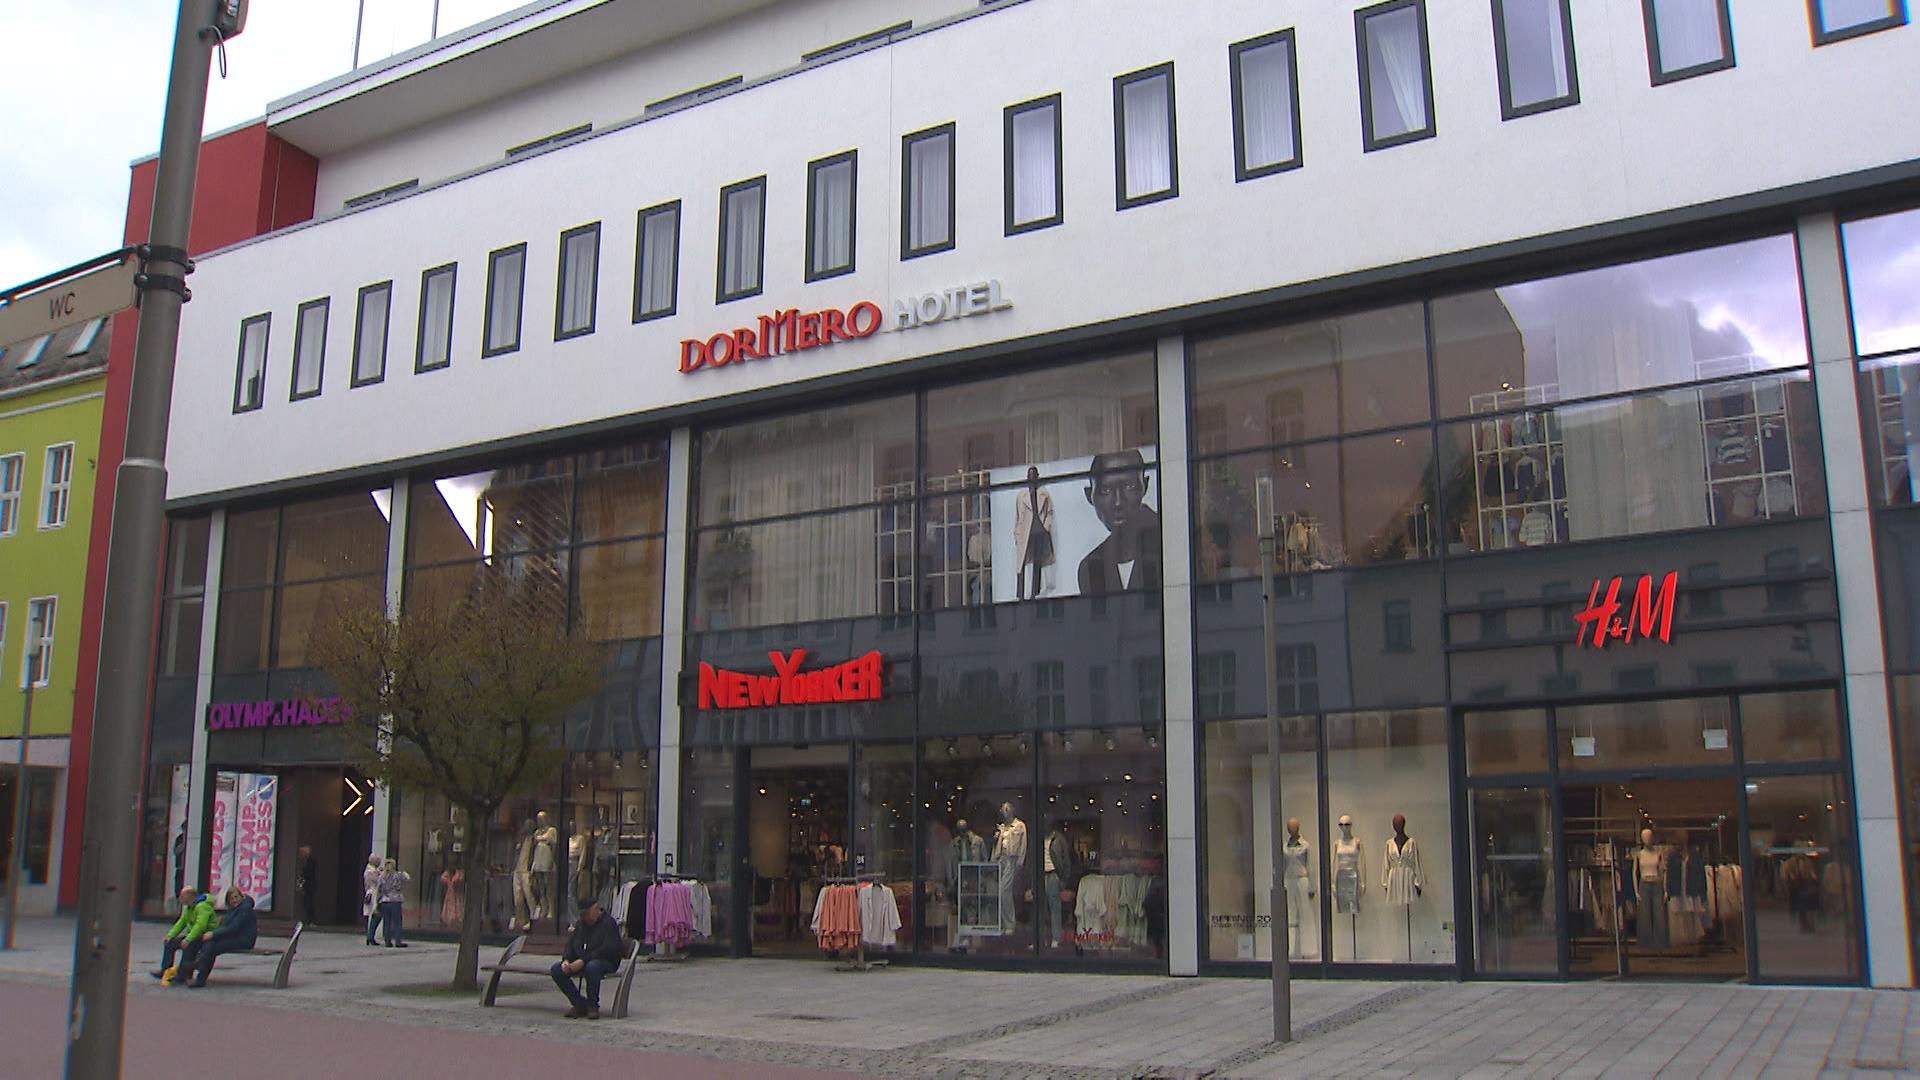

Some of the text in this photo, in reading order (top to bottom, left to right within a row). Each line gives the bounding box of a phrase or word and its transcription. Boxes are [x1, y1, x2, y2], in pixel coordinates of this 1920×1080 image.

[50, 291, 76, 320] WC
[678, 279, 1013, 374] DORMERO HOTEL
[1573, 570, 1678, 648] H&M
[253, 800, 273, 896] HADES
